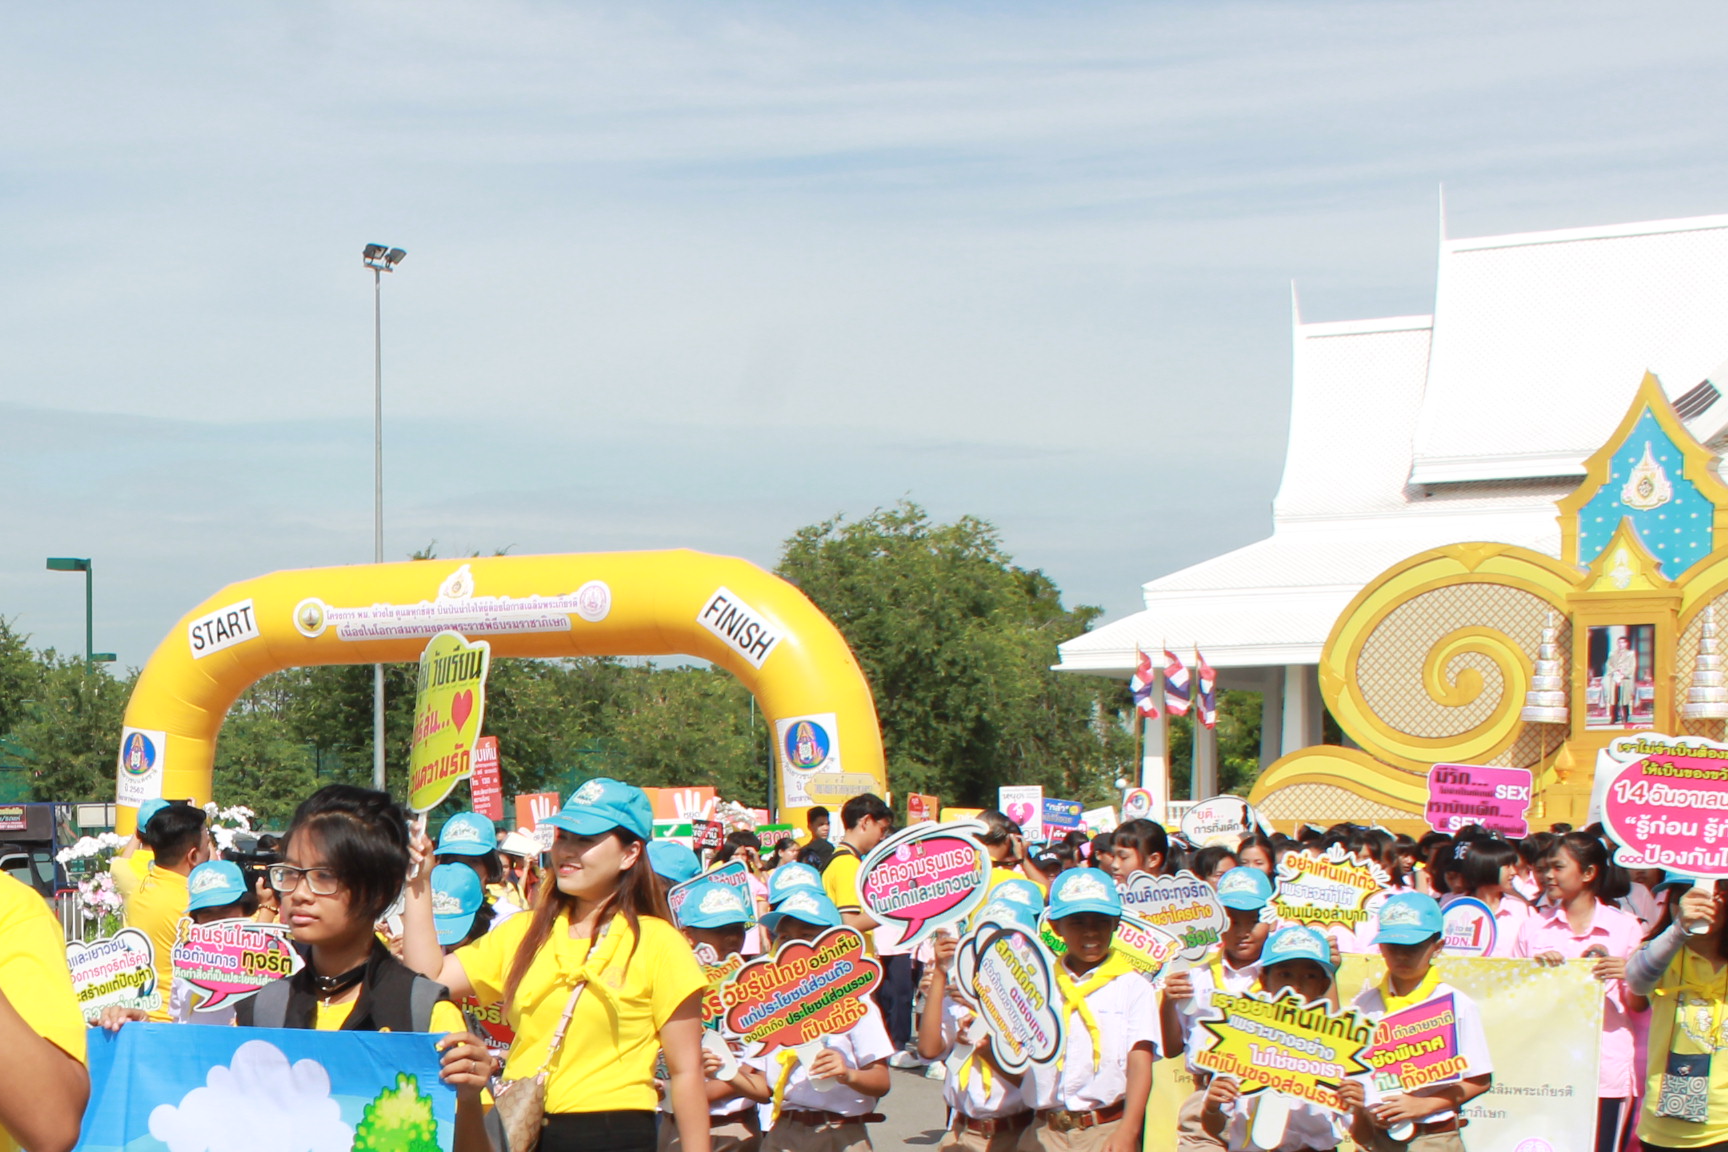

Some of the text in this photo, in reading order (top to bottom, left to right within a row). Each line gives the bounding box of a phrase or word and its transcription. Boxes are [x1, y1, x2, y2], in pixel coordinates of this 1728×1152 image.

[192, 606, 253, 650] START
[704, 595, 775, 661] FINISH
[1617, 738, 1728, 759] เราไม่จำเป็นต้อง
[1495, 784, 1529, 800] SEX
[1615, 782, 1647, 804] 14
[870, 870, 982, 914] ในเด็กและเยาวชน
[190, 923, 266, 951] คนรุ่นใหม่
[242, 948, 294, 975] ทุจริต
[722, 957, 807, 1007] วัยรุ่นไทย
[809, 934, 860, 970] อย่าเห็น
[739, 959, 854, 1029] แก่ประโยชน์ส่วนตัว
[785, 970, 875, 1026] ประโยชน์ส่วนรวม
[801, 999, 869, 1044] เป็นที่ตั้ง
[1228, 1013, 1336, 1062] เพราะบางอย่าง
[1249, 1043, 1346, 1079] ไม่ใช่ของเรา
